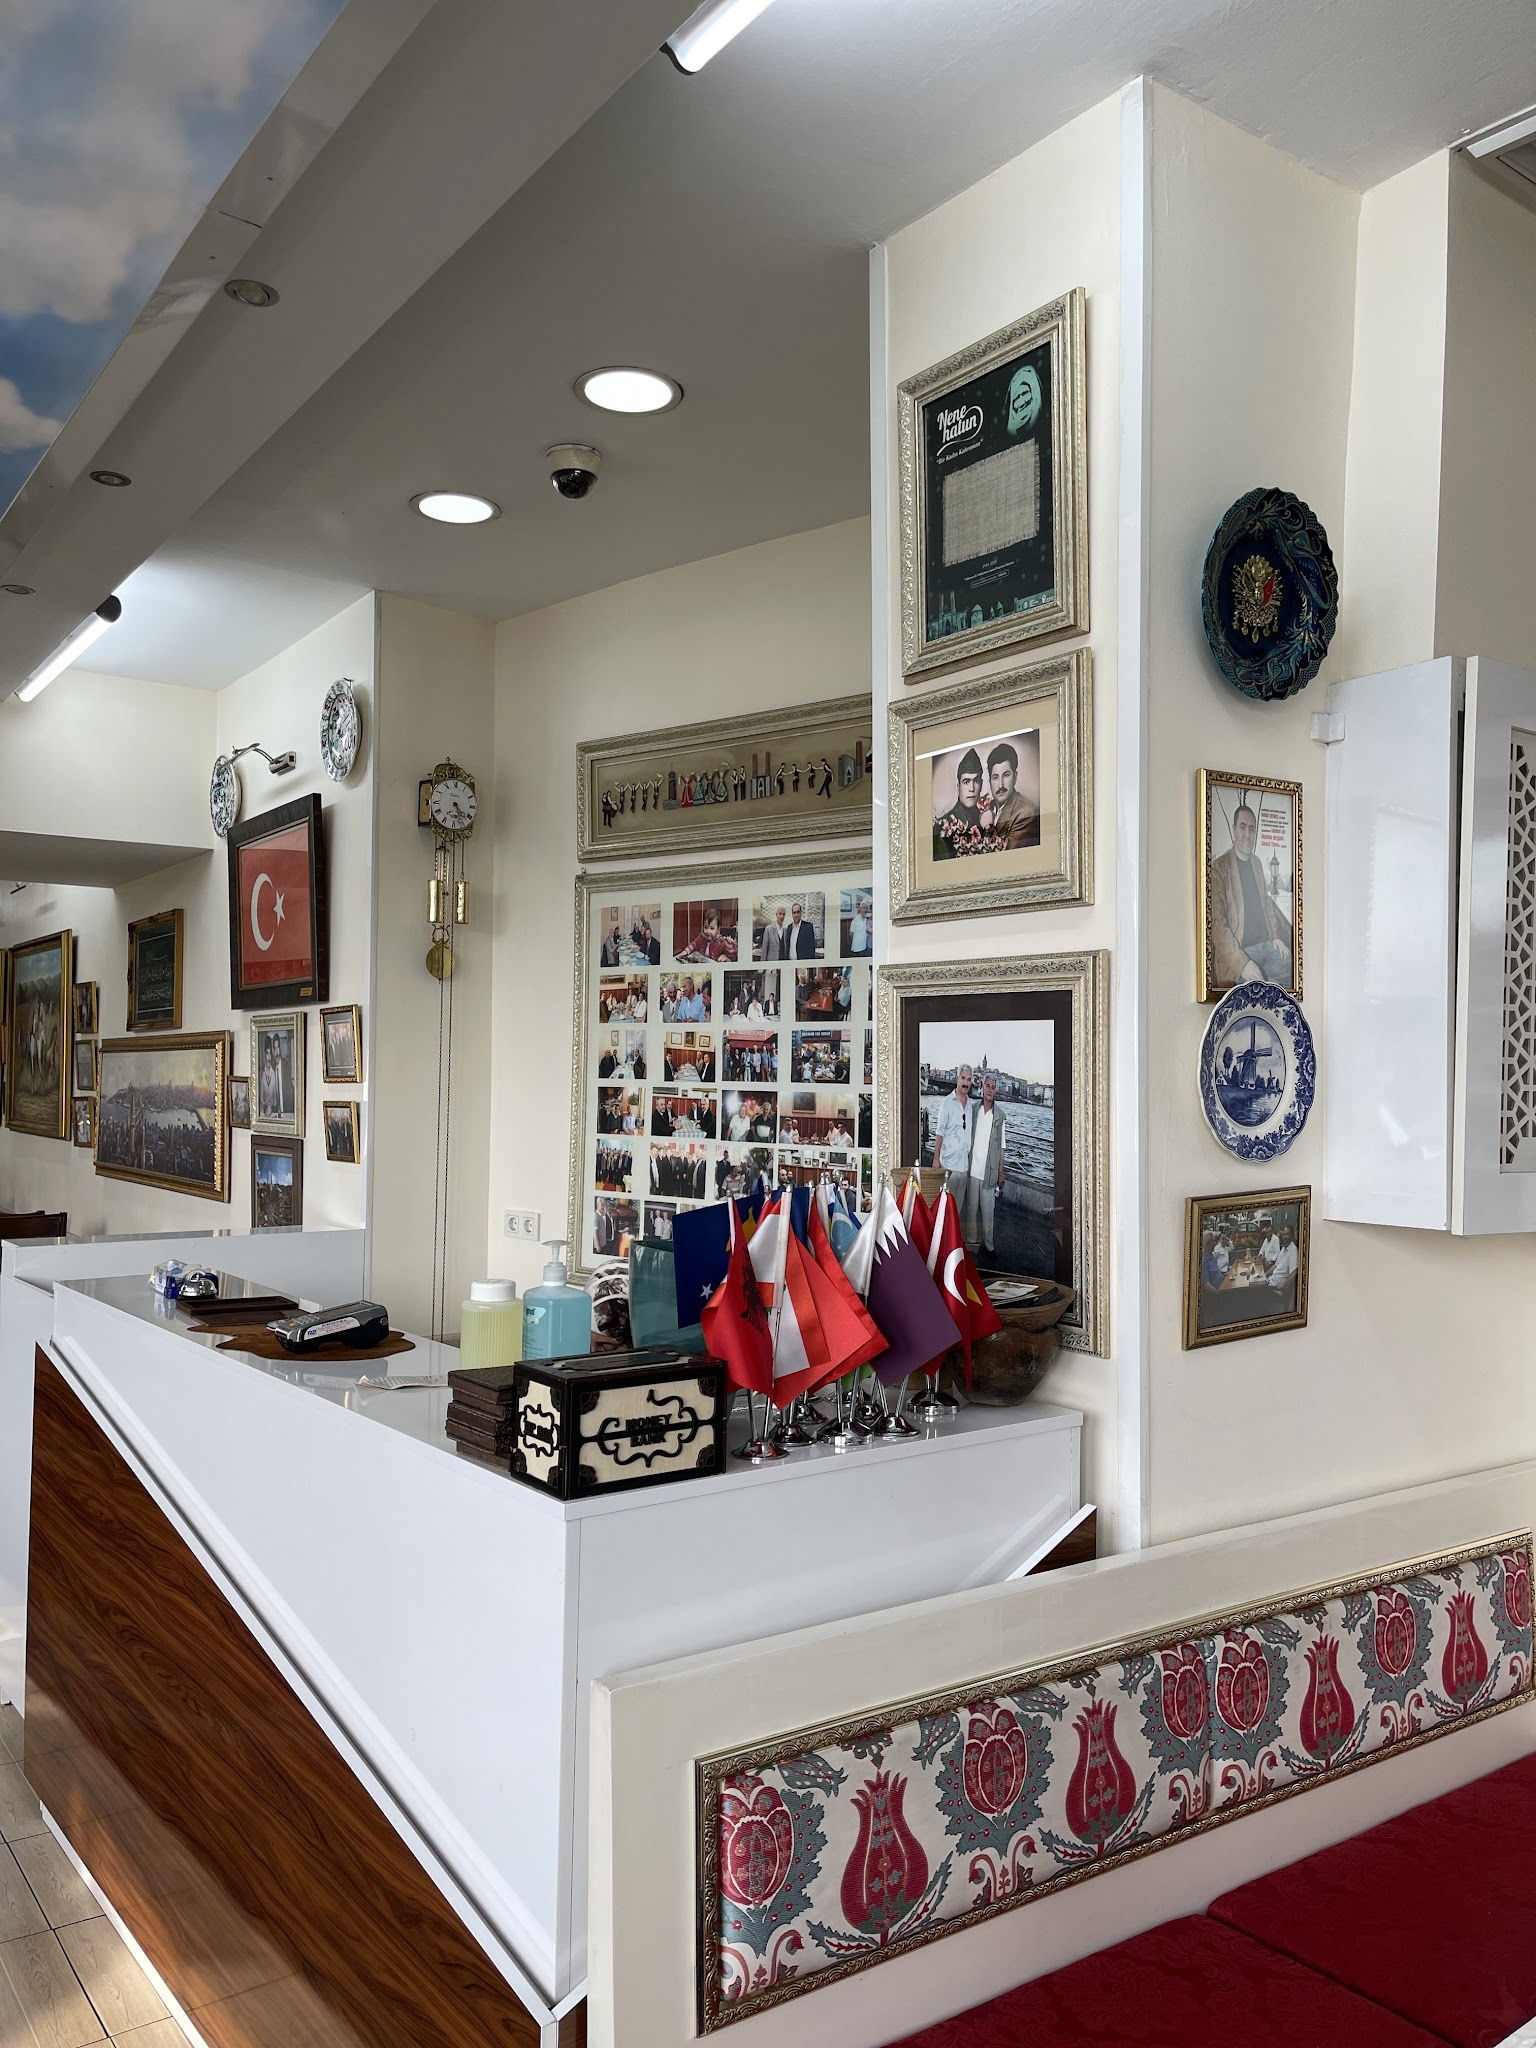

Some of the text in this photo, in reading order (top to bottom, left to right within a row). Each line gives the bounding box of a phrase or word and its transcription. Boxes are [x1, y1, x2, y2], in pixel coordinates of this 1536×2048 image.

[937, 405, 967, 430] Nene
[942, 415, 977, 443] hatun
[625, 1414, 672, 1433] MONEY
